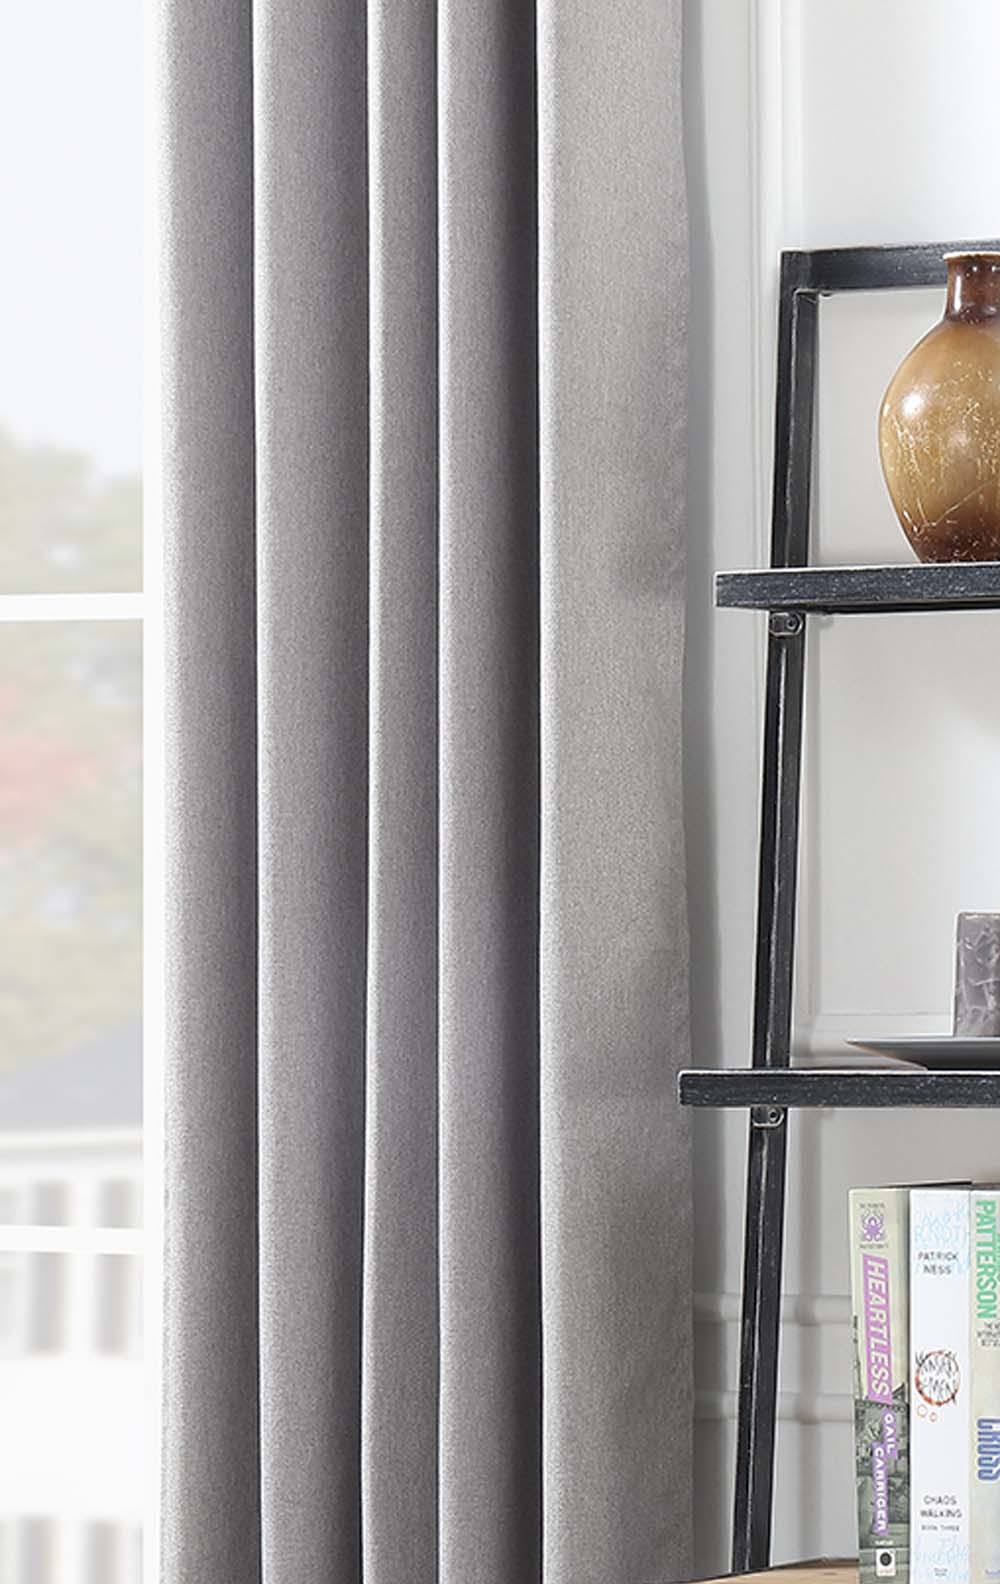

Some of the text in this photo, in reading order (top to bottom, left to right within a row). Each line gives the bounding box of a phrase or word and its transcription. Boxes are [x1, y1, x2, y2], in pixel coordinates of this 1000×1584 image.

[918, 1251, 959, 1261] PATRICK
[976, 1200, 998, 1319] PATTERSON
[923, 1265, 952, 1275] NESS
[866, 1260, 889, 1396] HEARTLESS
[884, 1413, 896, 1454] GAIL
[923, 1495, 957, 1506] CHAOS
